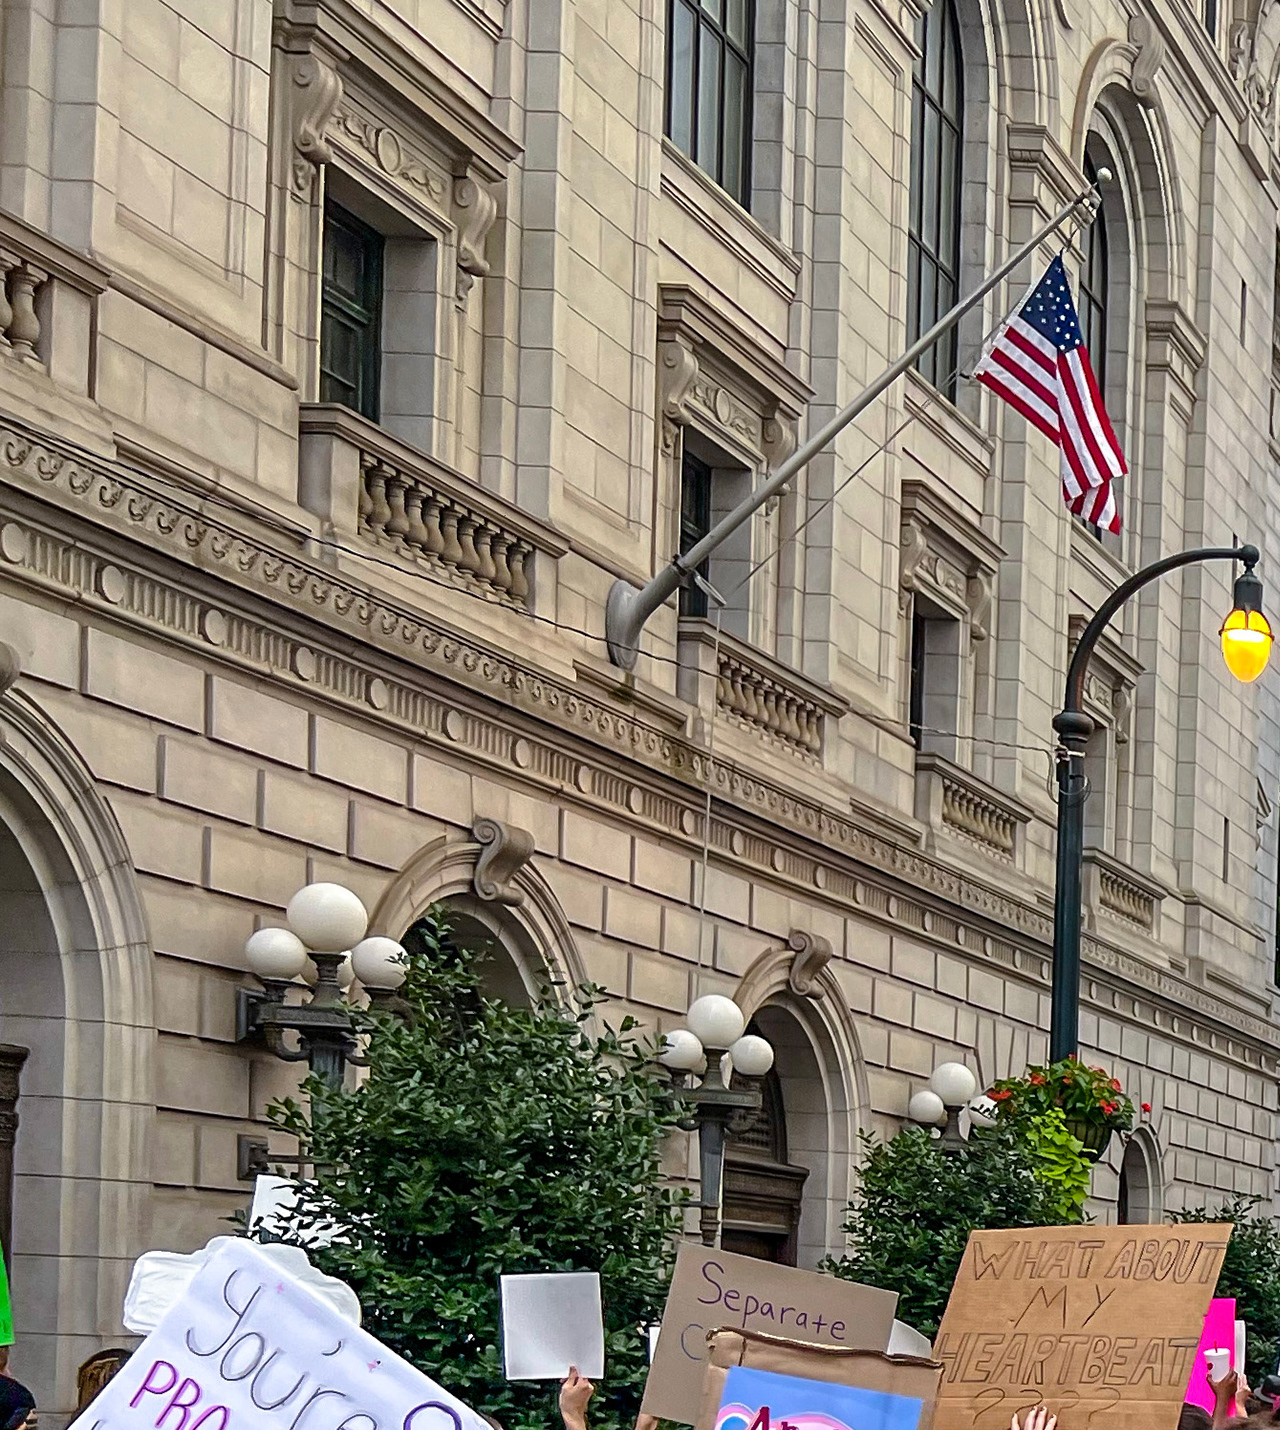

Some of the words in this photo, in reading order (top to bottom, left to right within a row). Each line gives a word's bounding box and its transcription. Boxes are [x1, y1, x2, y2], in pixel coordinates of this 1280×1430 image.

[972, 1239, 1105, 1281] WHAT
[1104, 1238, 1229, 1285] ABOUT
[697, 1261, 847, 1341] Separate
[1013, 1284, 1117, 1329] MY
[940, 1333, 1200, 1388] HEARTBEAT
